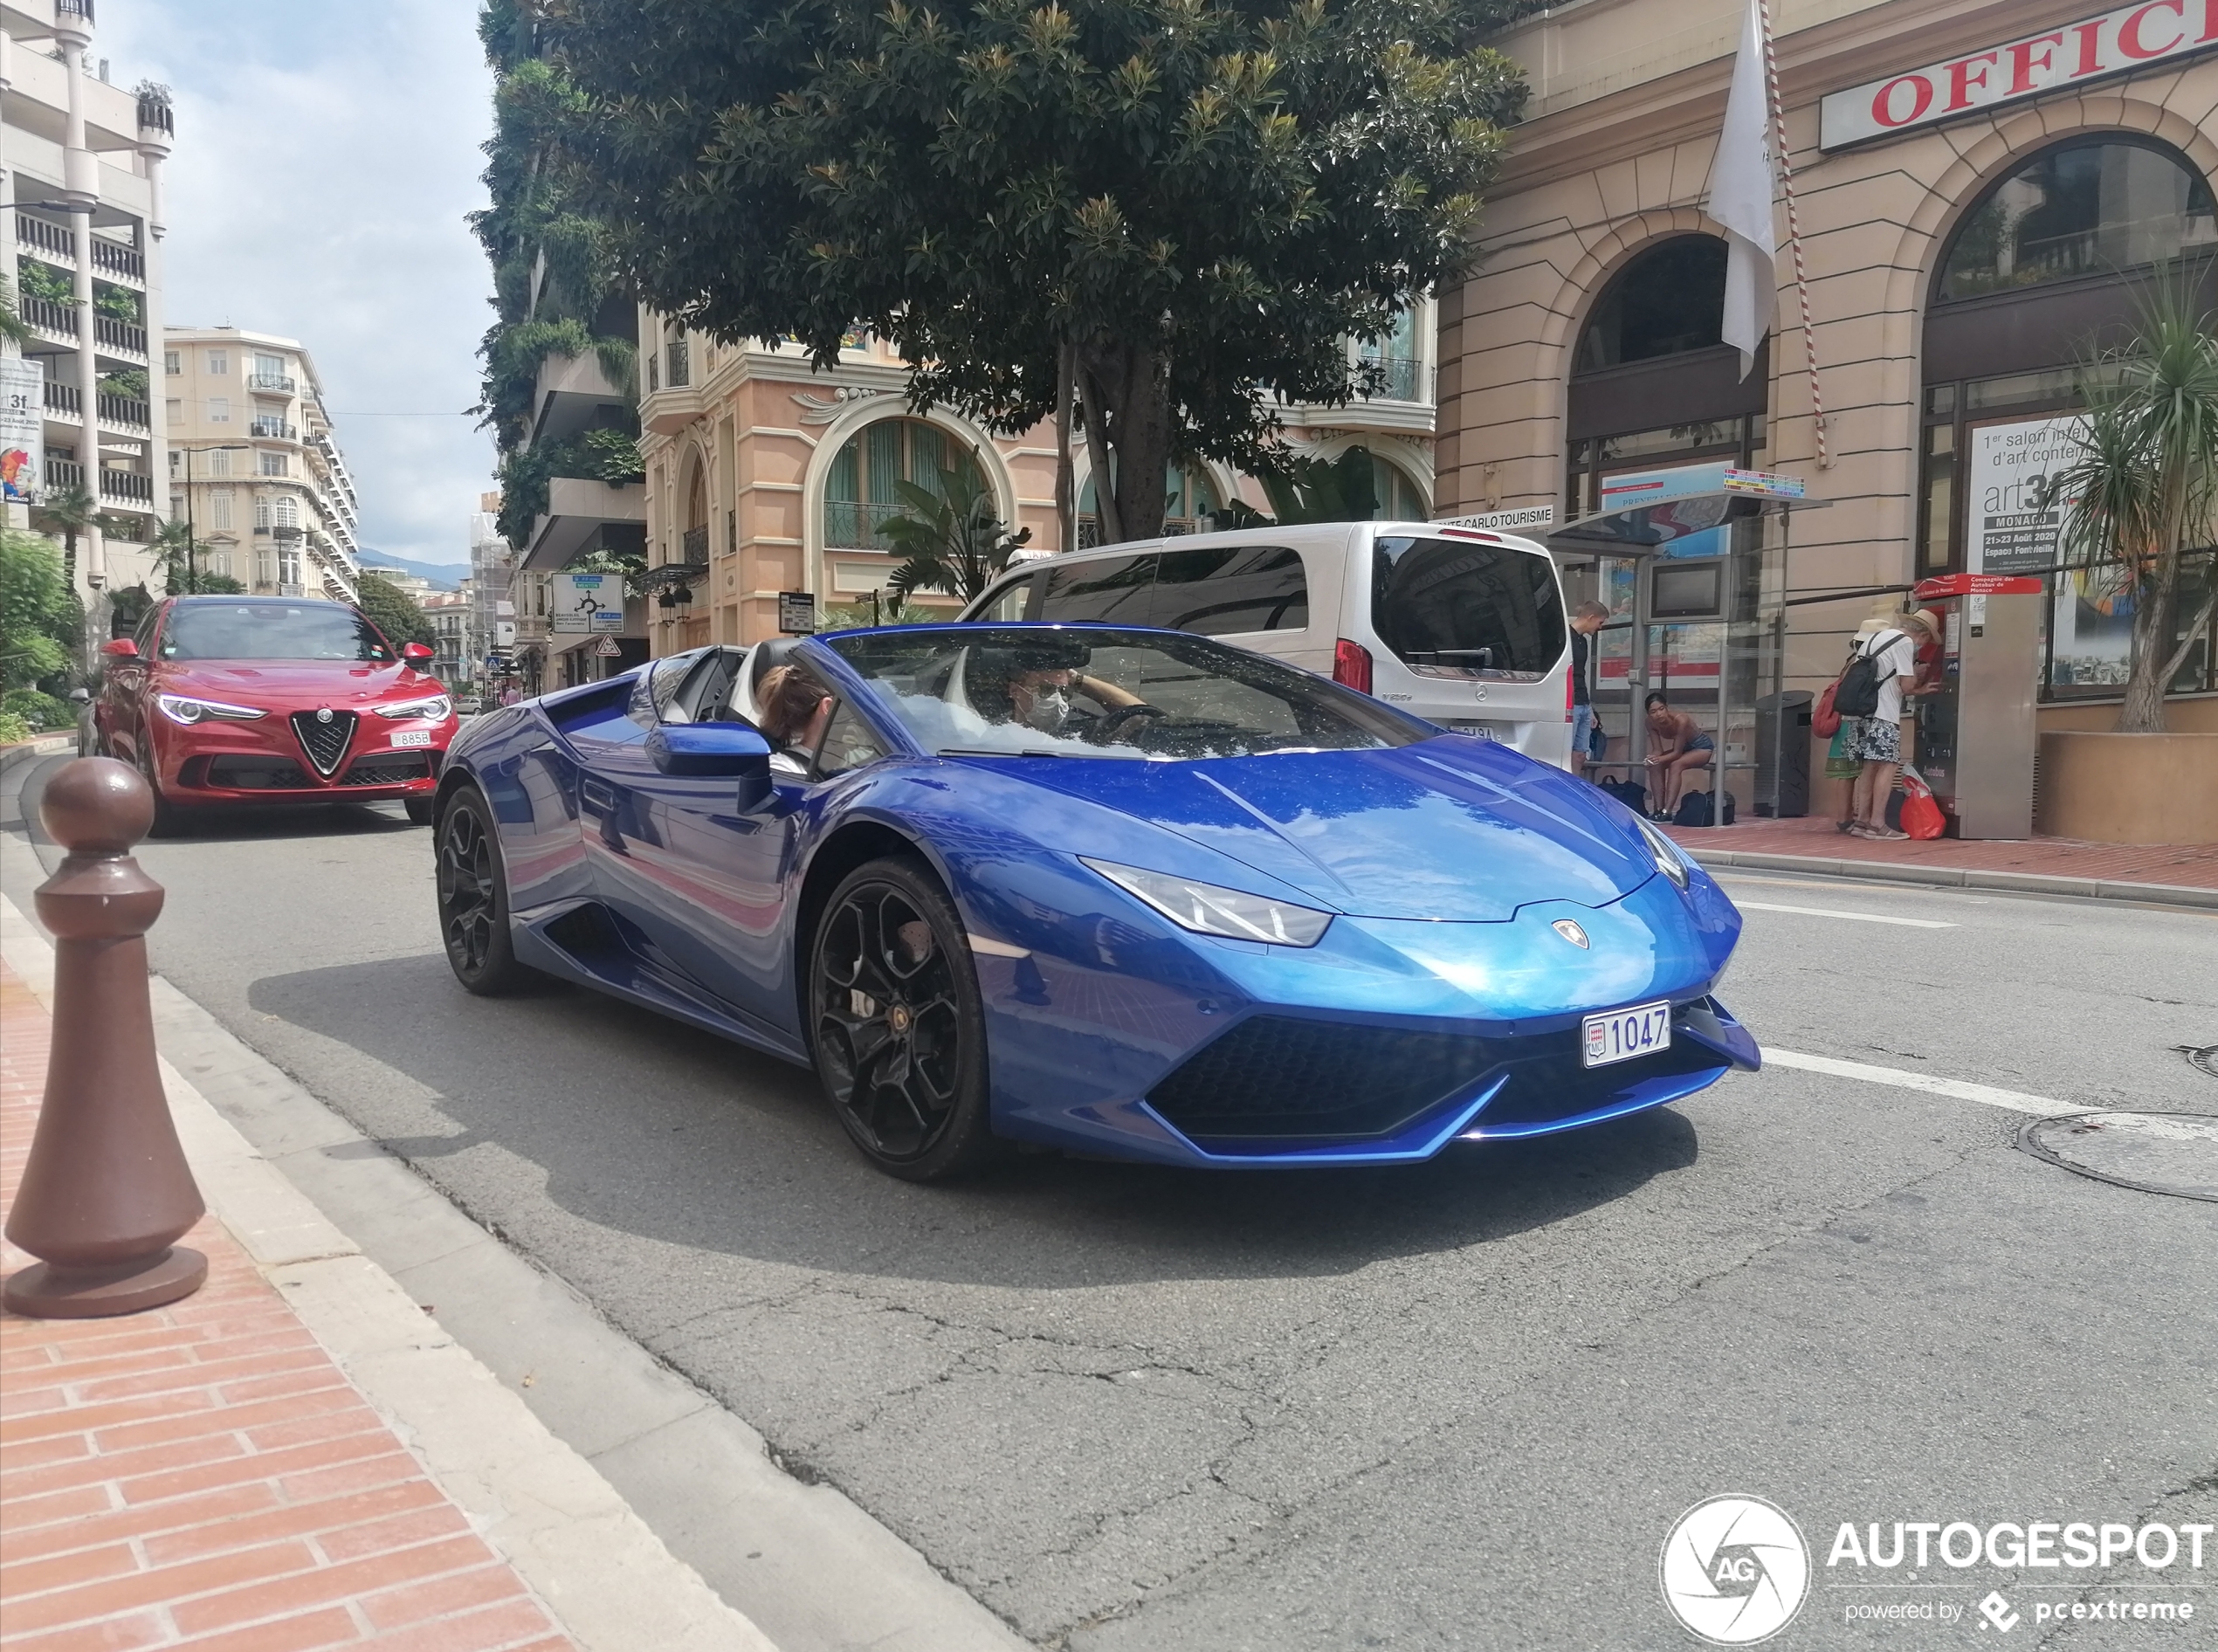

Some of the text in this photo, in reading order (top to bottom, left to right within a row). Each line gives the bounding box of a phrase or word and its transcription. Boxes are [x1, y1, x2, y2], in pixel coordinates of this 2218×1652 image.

[2006, 430, 2046, 446] salon
[2051, 425, 2097, 441] inter
[1499, 508, 1552, 527] TOURISME
[1995, 513, 2047, 527] MONACO
[1985, 531, 2056, 545] 21>23 Août 2020
[1985, 547, 2012, 558] Espace
[402, 733, 429, 745] 885B
[1923, 765, 1945, 777] Autobus
[1612, 1008, 1667, 1055] 1047
